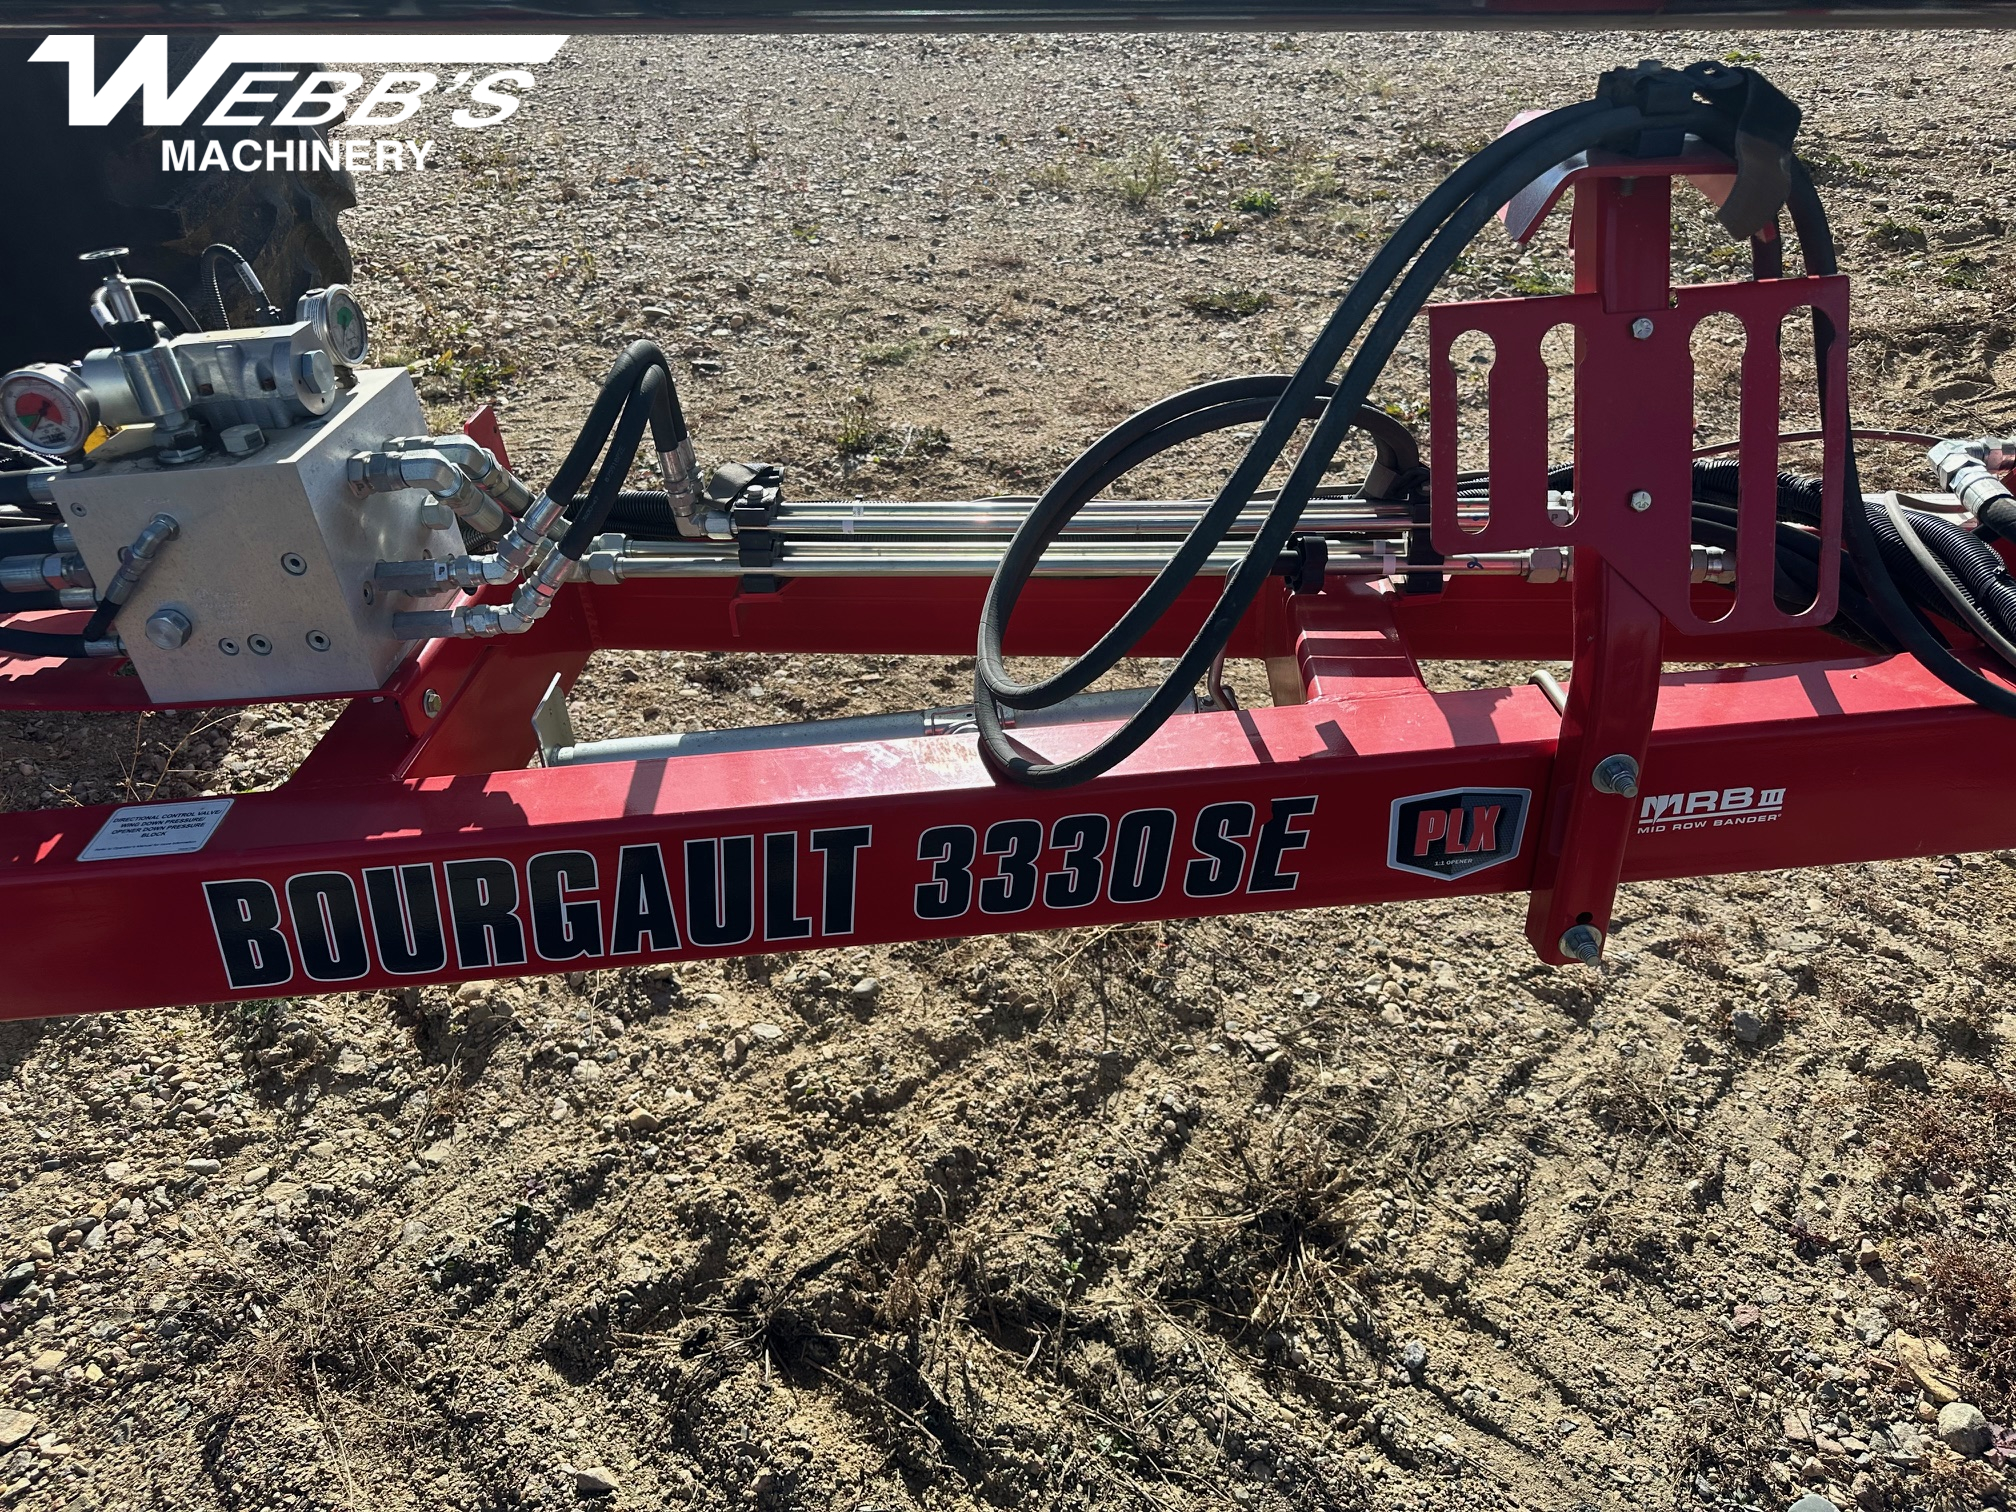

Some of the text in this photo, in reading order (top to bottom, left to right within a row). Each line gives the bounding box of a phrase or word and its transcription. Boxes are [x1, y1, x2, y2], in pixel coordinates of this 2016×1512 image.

[1757, 787, 1787, 807] III
[112, 814, 160, 823] DIRECTIONAL
[161, 811, 196, 820] CONTROL
[111, 827, 142, 835] OPENER
[165, 822, 206, 831] PRESSURE
[1413, 804, 1501, 857] PLX
[1636, 825, 1666, 834] MID
[1672, 820, 1708, 831] ROW
[201, 795, 1319, 990] BOURGAULT 3330 SE
